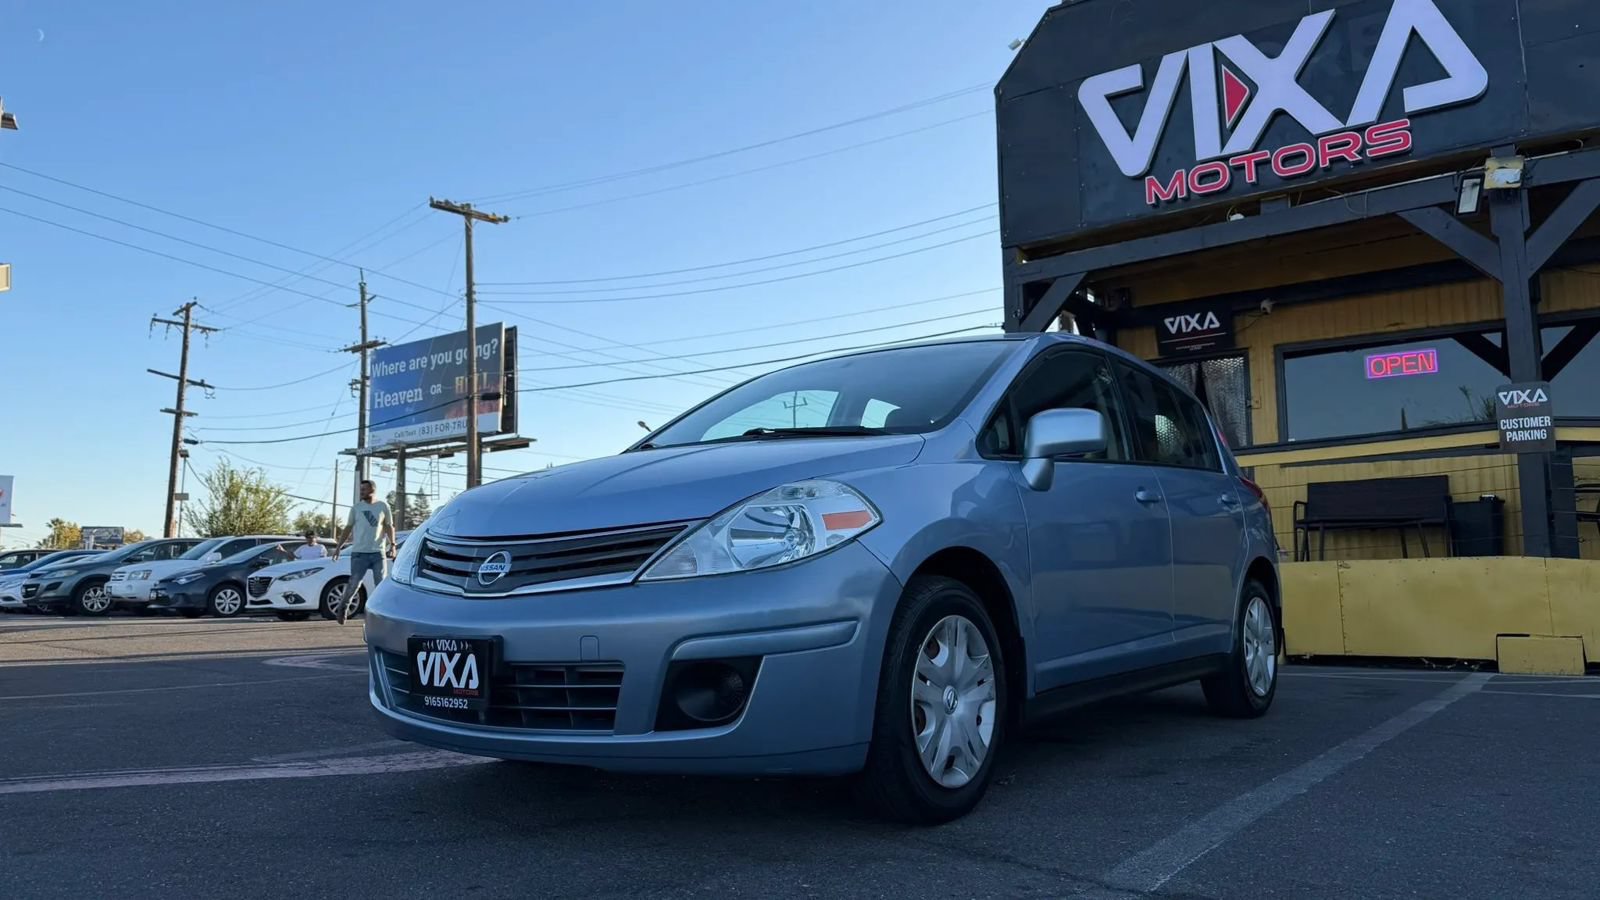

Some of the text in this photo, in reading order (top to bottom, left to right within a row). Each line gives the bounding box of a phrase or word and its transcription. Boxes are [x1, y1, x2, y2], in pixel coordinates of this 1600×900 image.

[1078, 0, 1489, 178] VIXA
[1145, 118, 1412, 206] MOTORS
[1164, 311, 1220, 334] VIXA
[371, 338, 499, 379] Where are you gong?
[1370, 351, 1434, 377] OPEN
[374, 387, 423, 409] Heaven
[430, 384, 442, 395] OR
[1498, 388, 1548, 405] VIXA
[1500, 416, 1551, 430] CUSTOMER
[1506, 429, 1547, 442] PARKING
[436, 639, 458, 652] VIXA
[417, 651, 480, 690] VIXA
[424, 696, 469, 709] 9165162952
